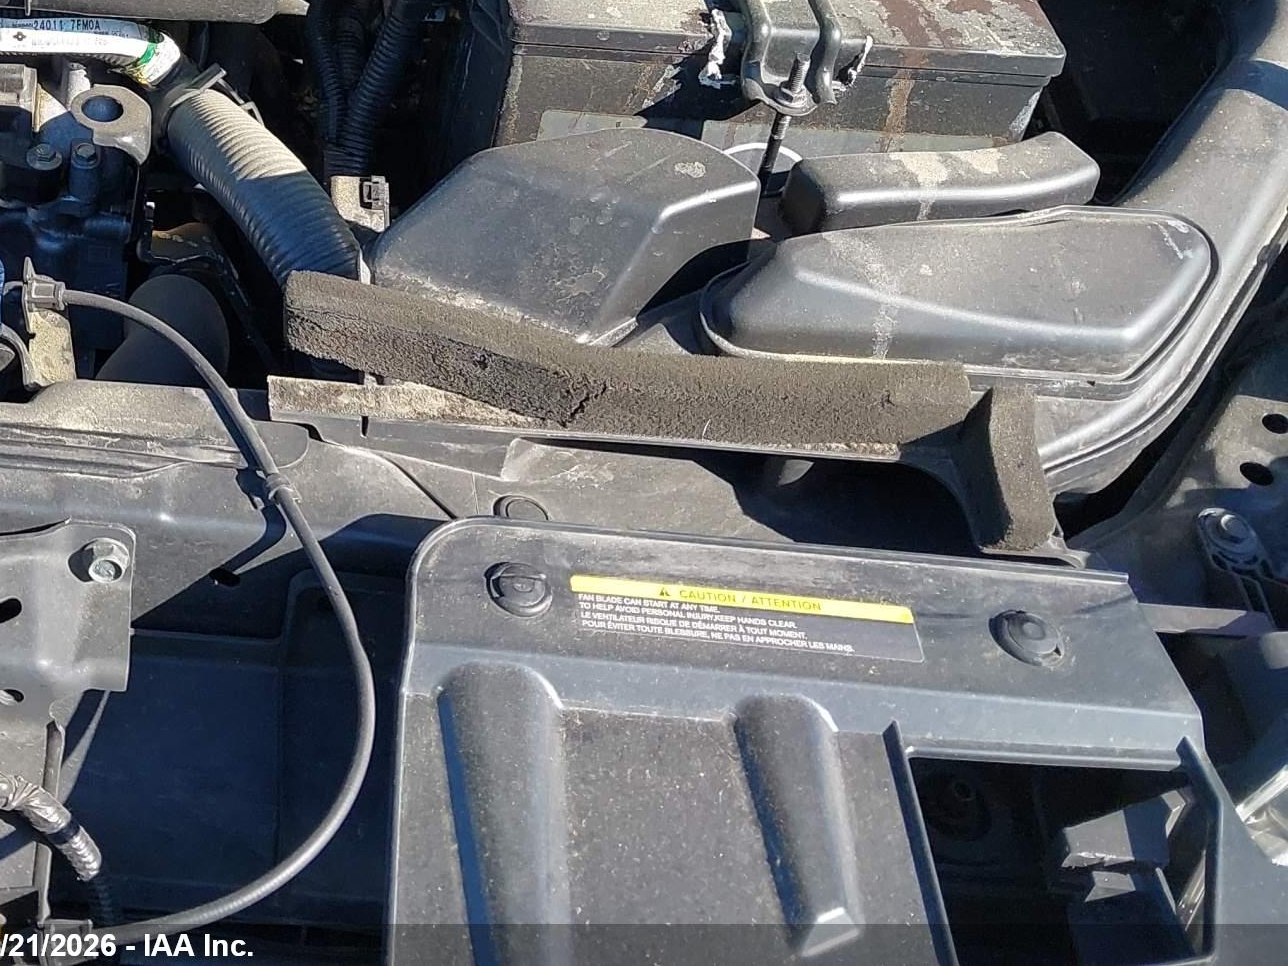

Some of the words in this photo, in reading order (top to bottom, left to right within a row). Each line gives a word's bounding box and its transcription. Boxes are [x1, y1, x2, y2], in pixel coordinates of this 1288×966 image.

[34, 19, 63, 30] 24011
[578, 593, 595, 602] FAN
[596, 595, 623, 604] BLADE
[623, 597, 642, 606] CAN
[643, 599, 669, 608] START
[669, 601, 680, 609] AT
[681, 602, 698, 611] ANY
[699, 604, 721, 614] TIME.
[679, 589, 736, 603] CAUTION
[751, 596, 822, 611] ATTENTION
[579, 601, 591, 610] TO
[592, 603, 614, 612] HELP
[614, 604, 640, 614] AVOID
[641, 607, 685, 619] PERSONAL
[737, 617, 767, 626] HANDS
[767, 619, 798, 629] CLEAR.
[581, 611, 591, 619] LE
[591, 613, 645, 625] VENTILATEUR
[646, 616, 677, 627] RISQUE
[678, 619, 690, 628] DE
[691, 618, 737, 633] DÉMARRER
[746, 625, 768, 635] TOUT
[769, 628, 808, 640] MOMENT.
[582, 620, 606, 629] POUR
[606, 621, 636, 631] ÉVITER
[636, 625, 664, 634] TOUTE
[711, 631, 723, 640] NE
[724, 632, 741, 641] PAS
[742, 635, 754, 643] EN
[755, 636, 808, 648] APPROCHER
[808, 641, 825, 649] LES
[826, 642, 855, 652] MAINS.
